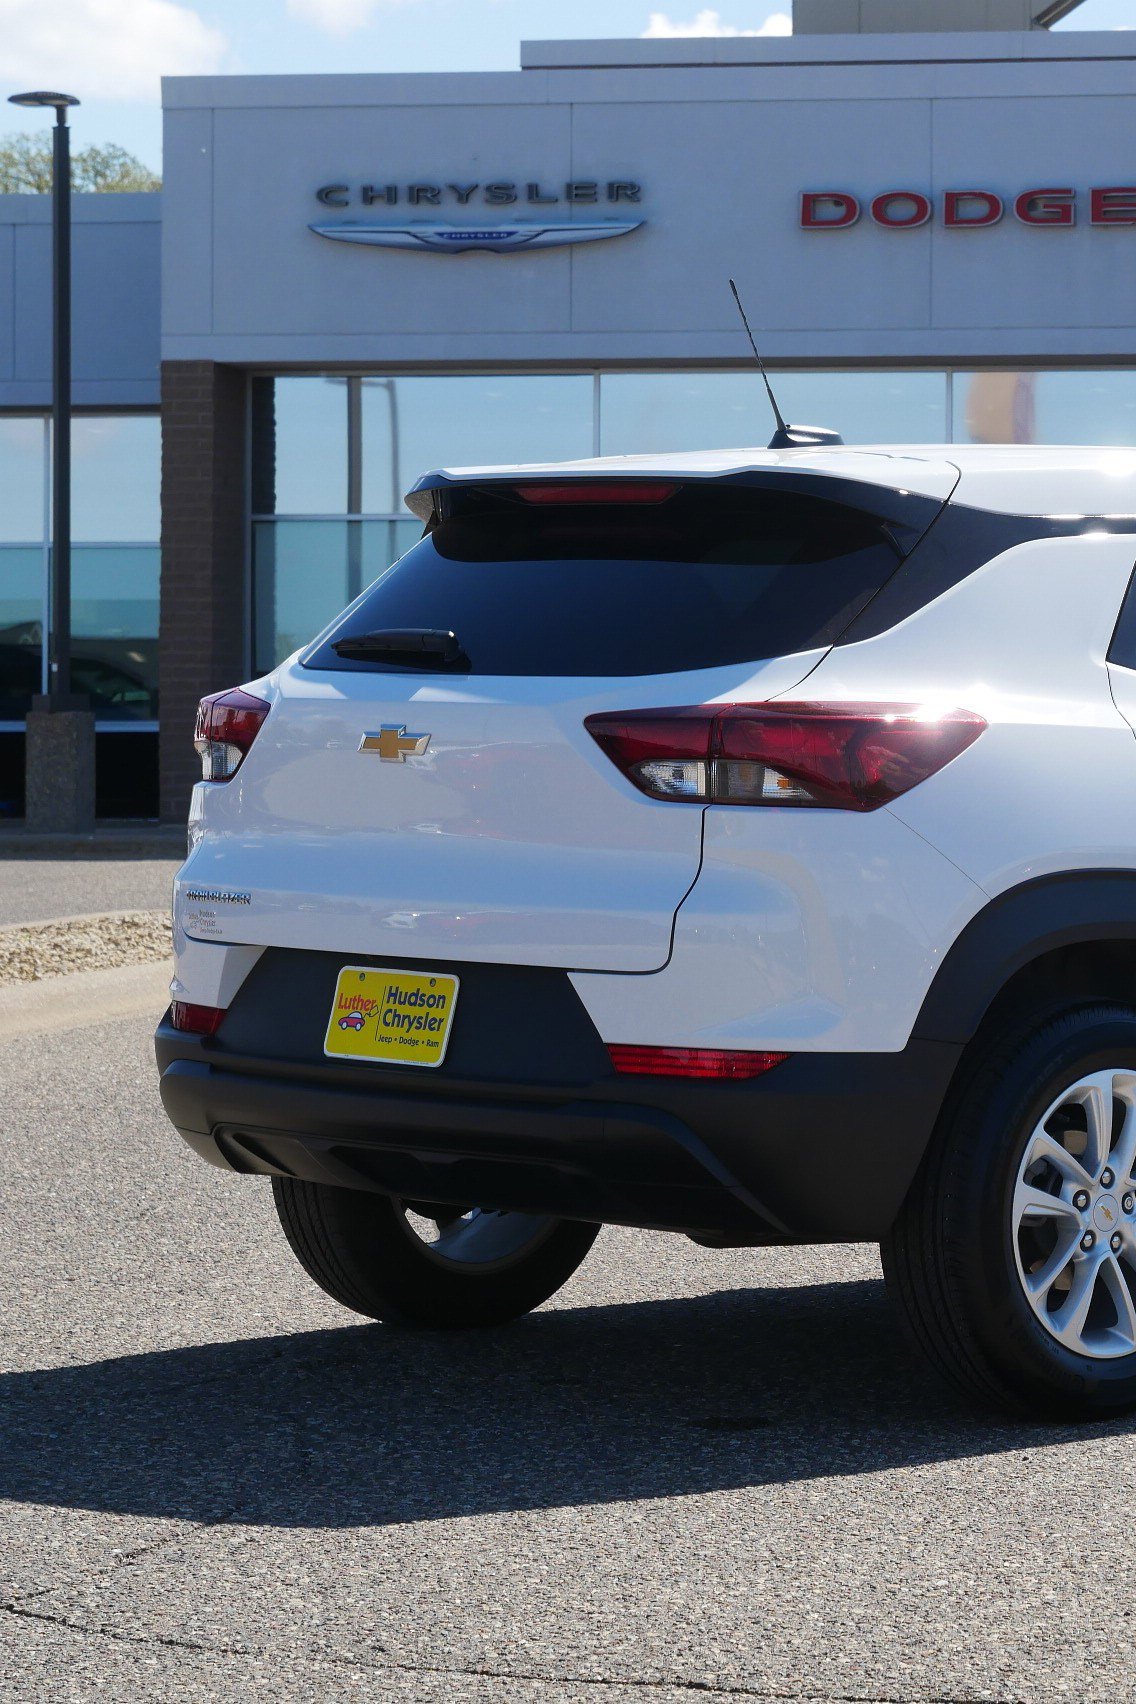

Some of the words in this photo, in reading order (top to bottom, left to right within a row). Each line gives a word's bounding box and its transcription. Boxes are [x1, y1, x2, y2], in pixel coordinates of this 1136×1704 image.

[315, 181, 641, 207] CHRYSLER
[337, 993, 376, 1011] Luther
[386, 986, 446, 1009] Hudson
[383, 1009, 445, 1033] Chrysler
[378, 1035, 393, 1045] Jeep
[399, 1036, 419, 1047] Dodge
[426, 1039, 439, 1048] Ram
